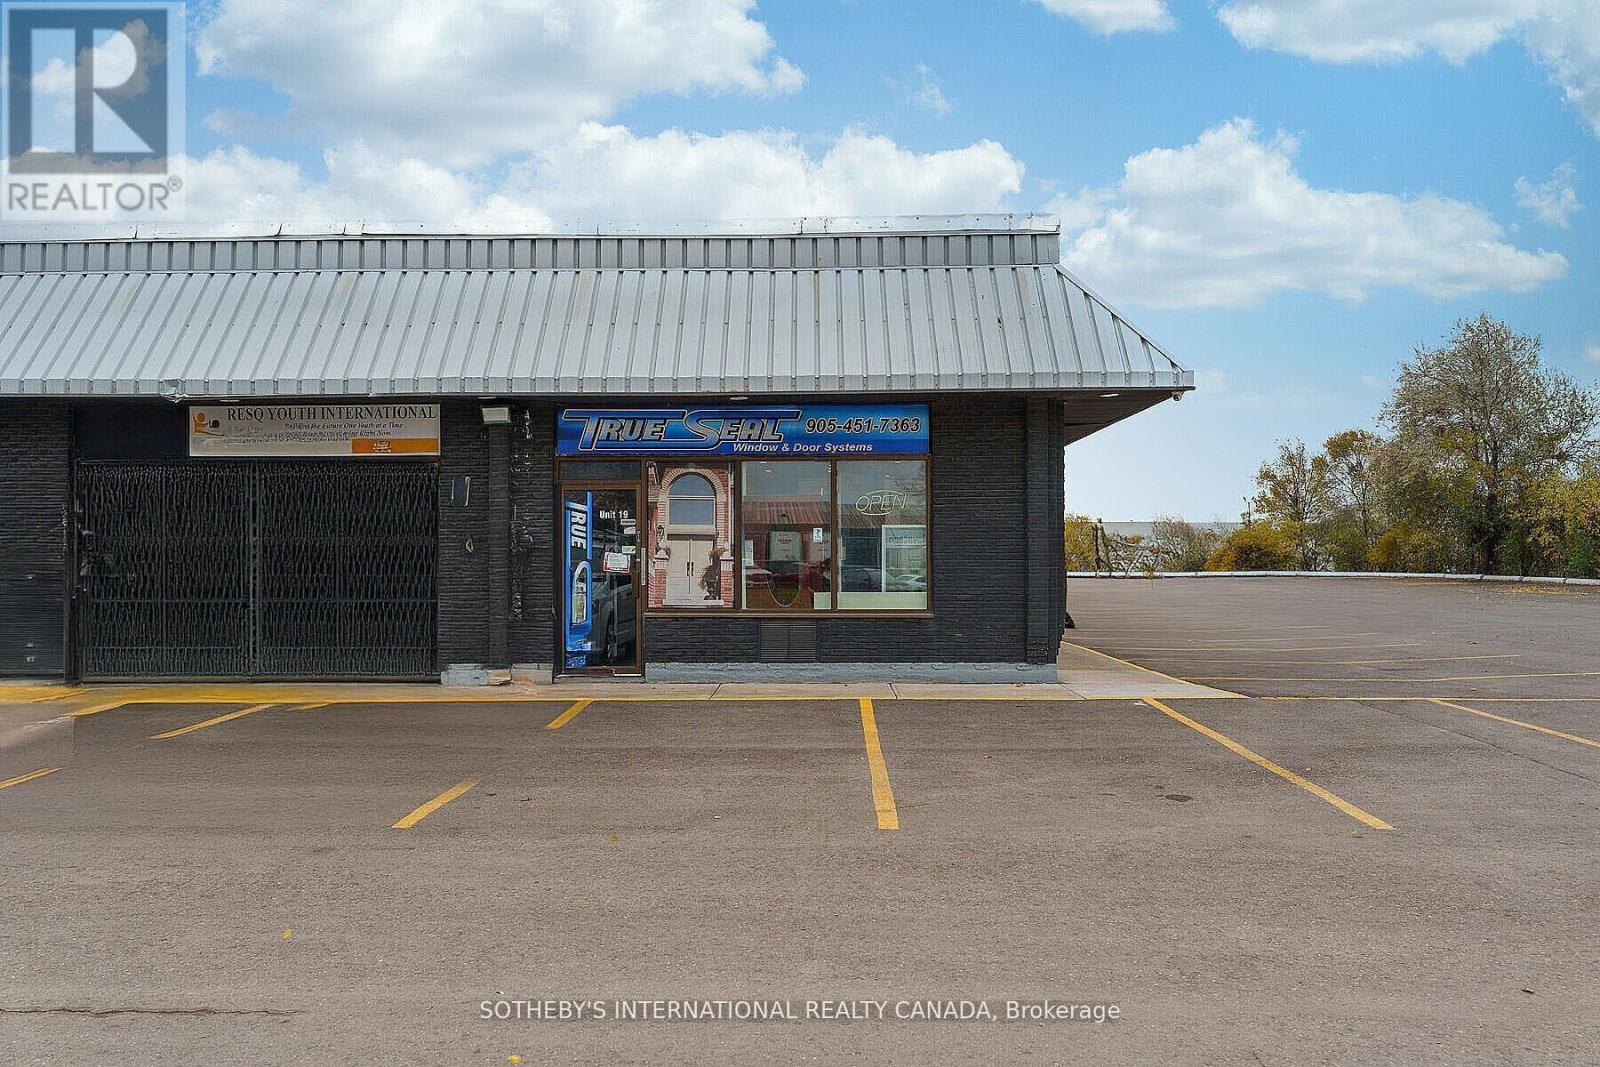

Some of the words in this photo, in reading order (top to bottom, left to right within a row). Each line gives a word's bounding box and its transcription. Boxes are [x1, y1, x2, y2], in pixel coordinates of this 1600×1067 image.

[227, 407, 264, 423] RESQ
[267, 407, 316, 421] YOUTH
[321, 405, 437, 419] INTERNATIONAL
[562, 409, 687, 451] TRUE
[684, 409, 802, 451] SEAL
[805, 417, 921, 434] 905-451-7363
[733, 443, 779, 452] Window
[781, 443, 790, 452] &
[793, 443, 821, 452] Door
[824, 443, 873, 454] Systems
[855, 494, 907, 512] OPEN
[599, 510, 616, 519] Unit
[619, 510, 629, 519] 19
[564, 491, 592, 559] TRUE
